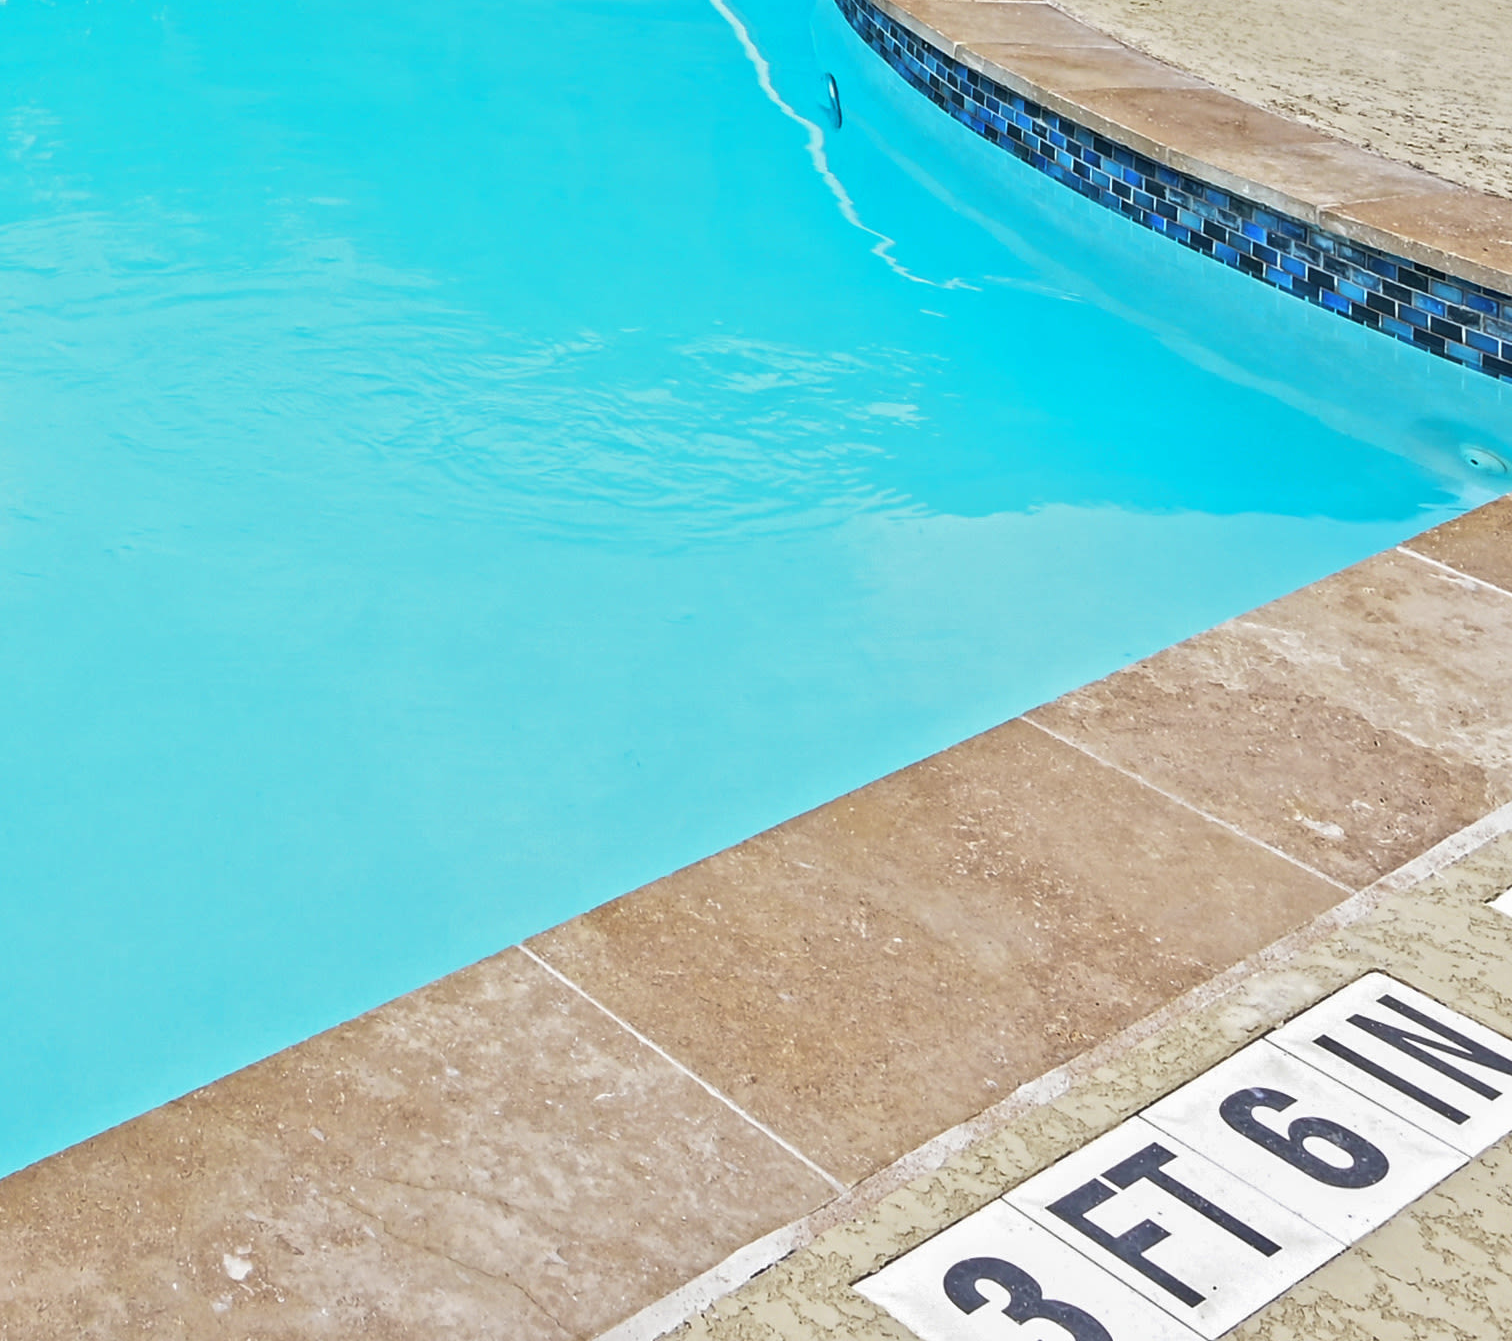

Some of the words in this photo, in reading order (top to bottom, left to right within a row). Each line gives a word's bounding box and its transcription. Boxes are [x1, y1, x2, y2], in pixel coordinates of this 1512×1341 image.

[943, 1256, 1114, 1341] 3
[1044, 1142, 1282, 1308] FT
[1219, 1086, 1390, 1189] 6
